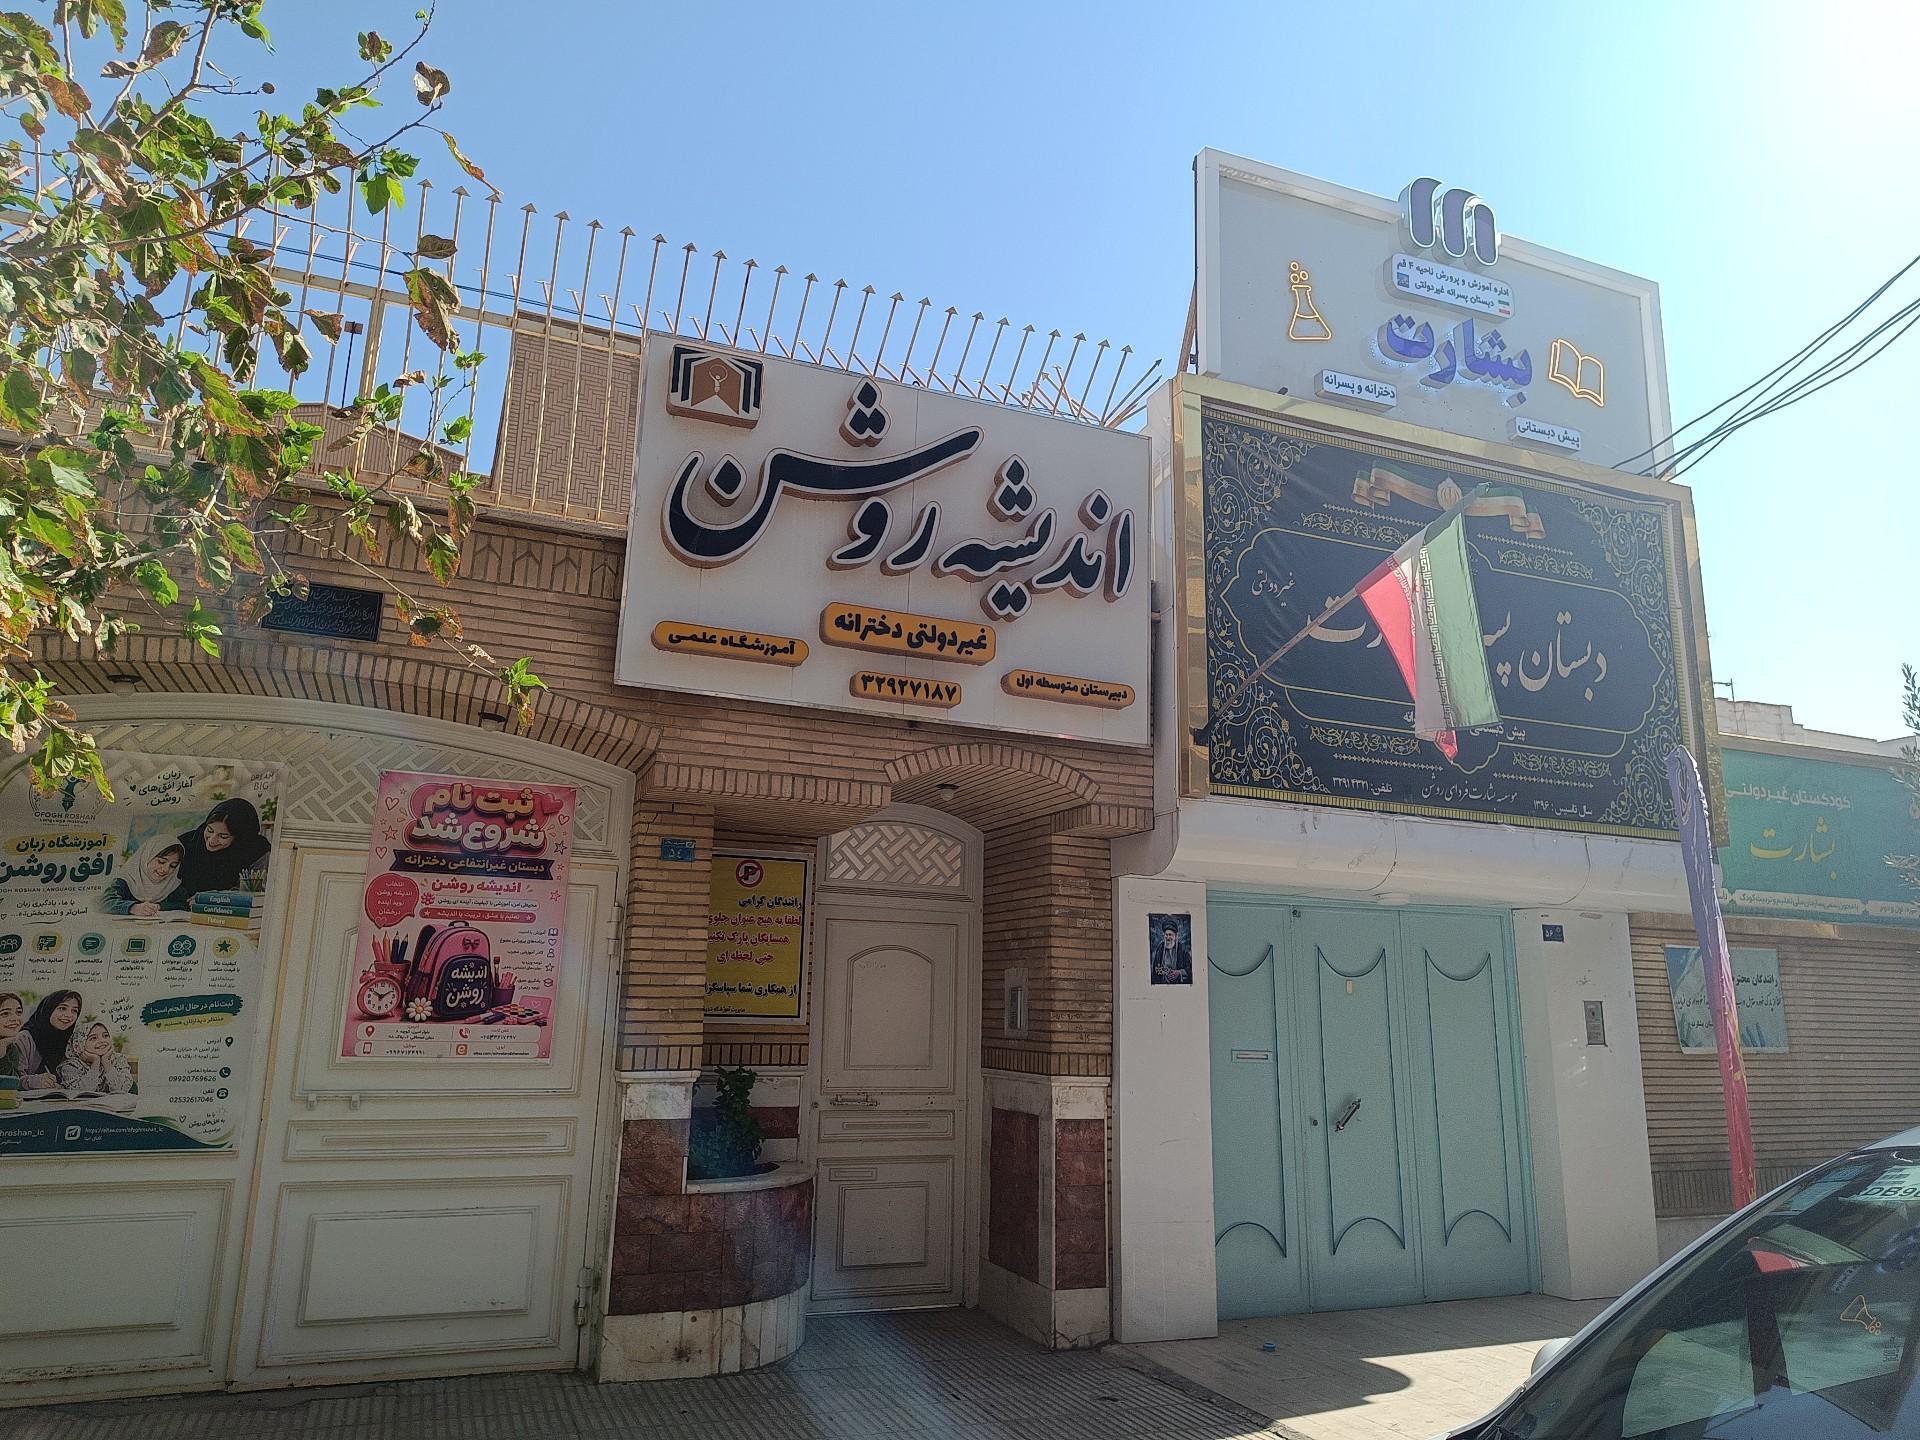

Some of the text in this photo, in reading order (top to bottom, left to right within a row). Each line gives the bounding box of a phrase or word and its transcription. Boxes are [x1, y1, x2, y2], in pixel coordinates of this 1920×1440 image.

[1396, 259, 1407, 269] قم
[1416, 265, 1434, 276] ناحیه
[1435, 270, 1460, 286] پرورش
[1468, 280, 1492, 292] آموزش
[1414, 281, 1494, 309] دبستان پسرانه غیردولتی
[1494, 287, 1509, 297] اداره
[1382, 313, 1533, 407] بشارت
[1324, 374, 1397, 399] دخترانه و پسرانه
[1517, 421, 1580, 449] پیش دبستانی
[663, 376, 1136, 622] اندیشه روشن
[1251, 569, 1296, 607] غیردولتی
[834, 612, 987, 656] غیردولتی دخترانه
[668, 631, 795, 656] آموزشگاه علمی
[1518, 611, 1608, 702] دبستان
[861, 674, 957, 702] ۳۲۹۲۷۱۸۷
[1016, 674, 1128, 702] دبیرستان متوسطه اول
[1507, 727, 1527, 742] پیش
[177, 776, 196, 792] آغاز
[253, 782, 269, 790] BIG
[1421, 773, 1445, 800] روشن
[150, 792, 182, 806] روشن
[424, 783, 534, 821] ثبت نام
[1468, 783, 1497, 811] بشارت
[1725, 783, 1853, 811] کودکستان غیردولتی
[34, 811, 96, 821] OFOGH ROSHAN
[1578, 804, 1593, 818] سال
[411, 812, 545, 851] شروع شد
[16, 832, 109, 853] آموزشگاه زبان
[1750, 816, 1836, 880] بشارت
[0, 852, 114, 885] افق روشن
[404, 854, 546, 874] دبستان غیرانتفاعی دخترانه
[431, 876, 522, 896] اندیشه روشن
[16, 900, 31, 909] زبان
[32, 899, 57, 908] یادگیری
[209, 896, 231, 904] English
[739, 895, 802, 909] رانندگان گرامی
[203, 906, 233, 915] Confidence
[378, 908, 401, 916] درخشان
[708, 912, 801, 927] لطفا به هیچ عنوان جلوی
[707, 931, 790, 946] همسایگان پارک نکنی
[716, 950, 774, 965] حتی لحظه ای
[450, 964, 488, 983] اندیشه
[1736, 974, 1778, 987] رانندگان محتر
[446, 983, 485, 1008] روشن
[704, 982, 798, 997] از همکاری شما سپاسگزا
[185, 1003, 199, 1012] حال
